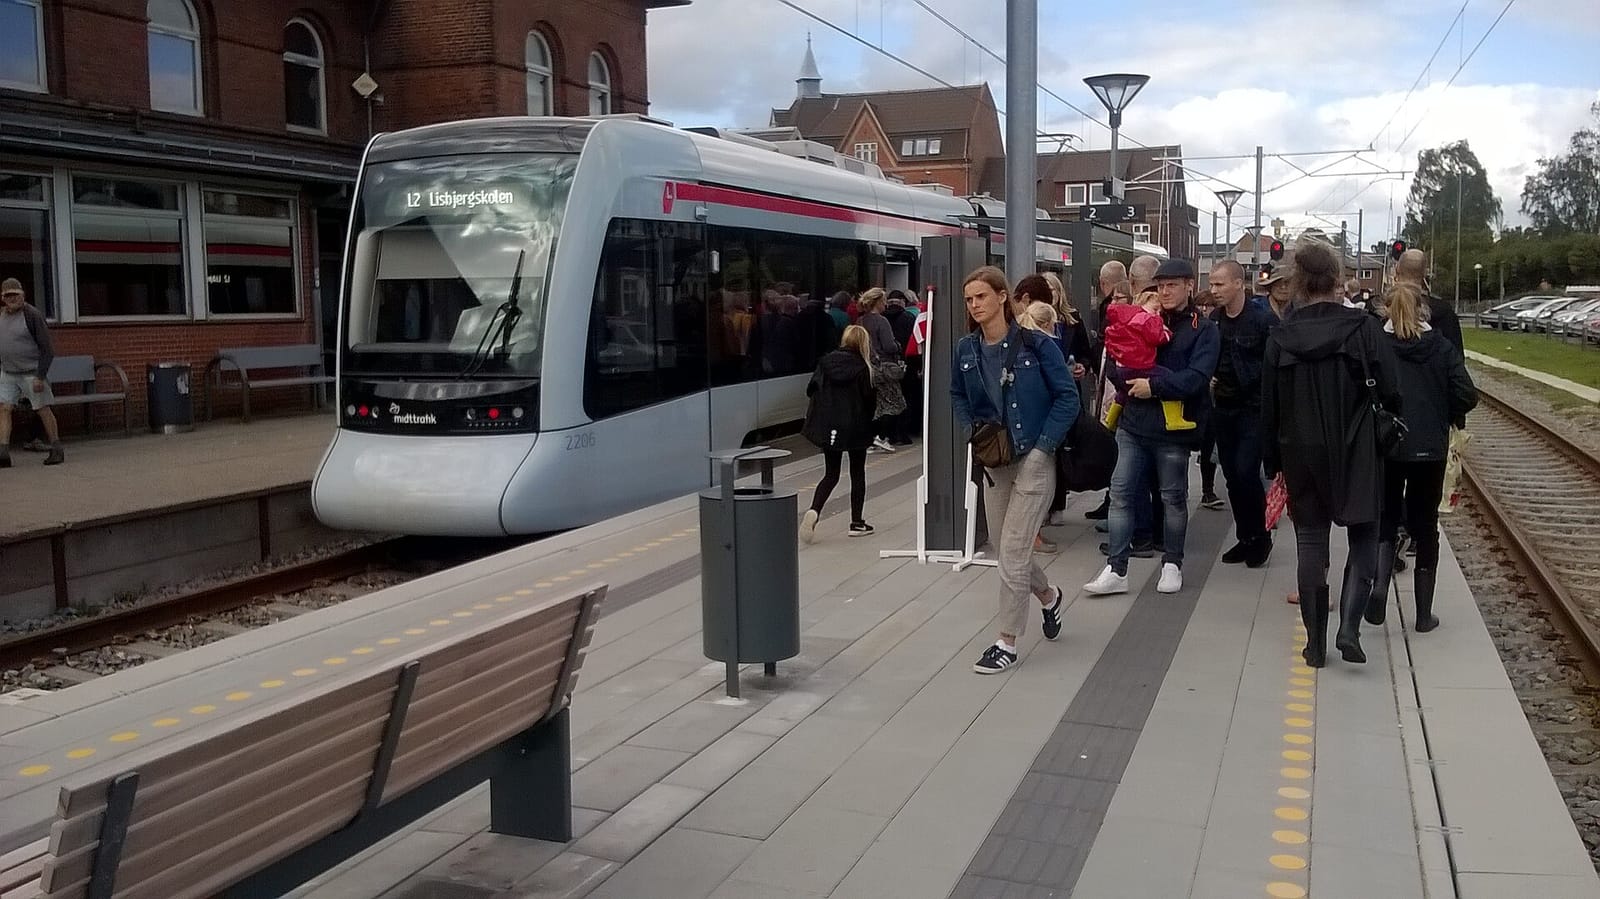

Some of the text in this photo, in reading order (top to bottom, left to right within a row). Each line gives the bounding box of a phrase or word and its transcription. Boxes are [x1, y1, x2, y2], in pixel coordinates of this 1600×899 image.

[407, 189, 513, 209] L2 Lisbjergskolen
[1089, 207, 1097, 219] 2
[1127, 206, 1135, 217] 3
[393, 412, 437, 425] midttrafik
[565, 431, 596, 450] 2206
